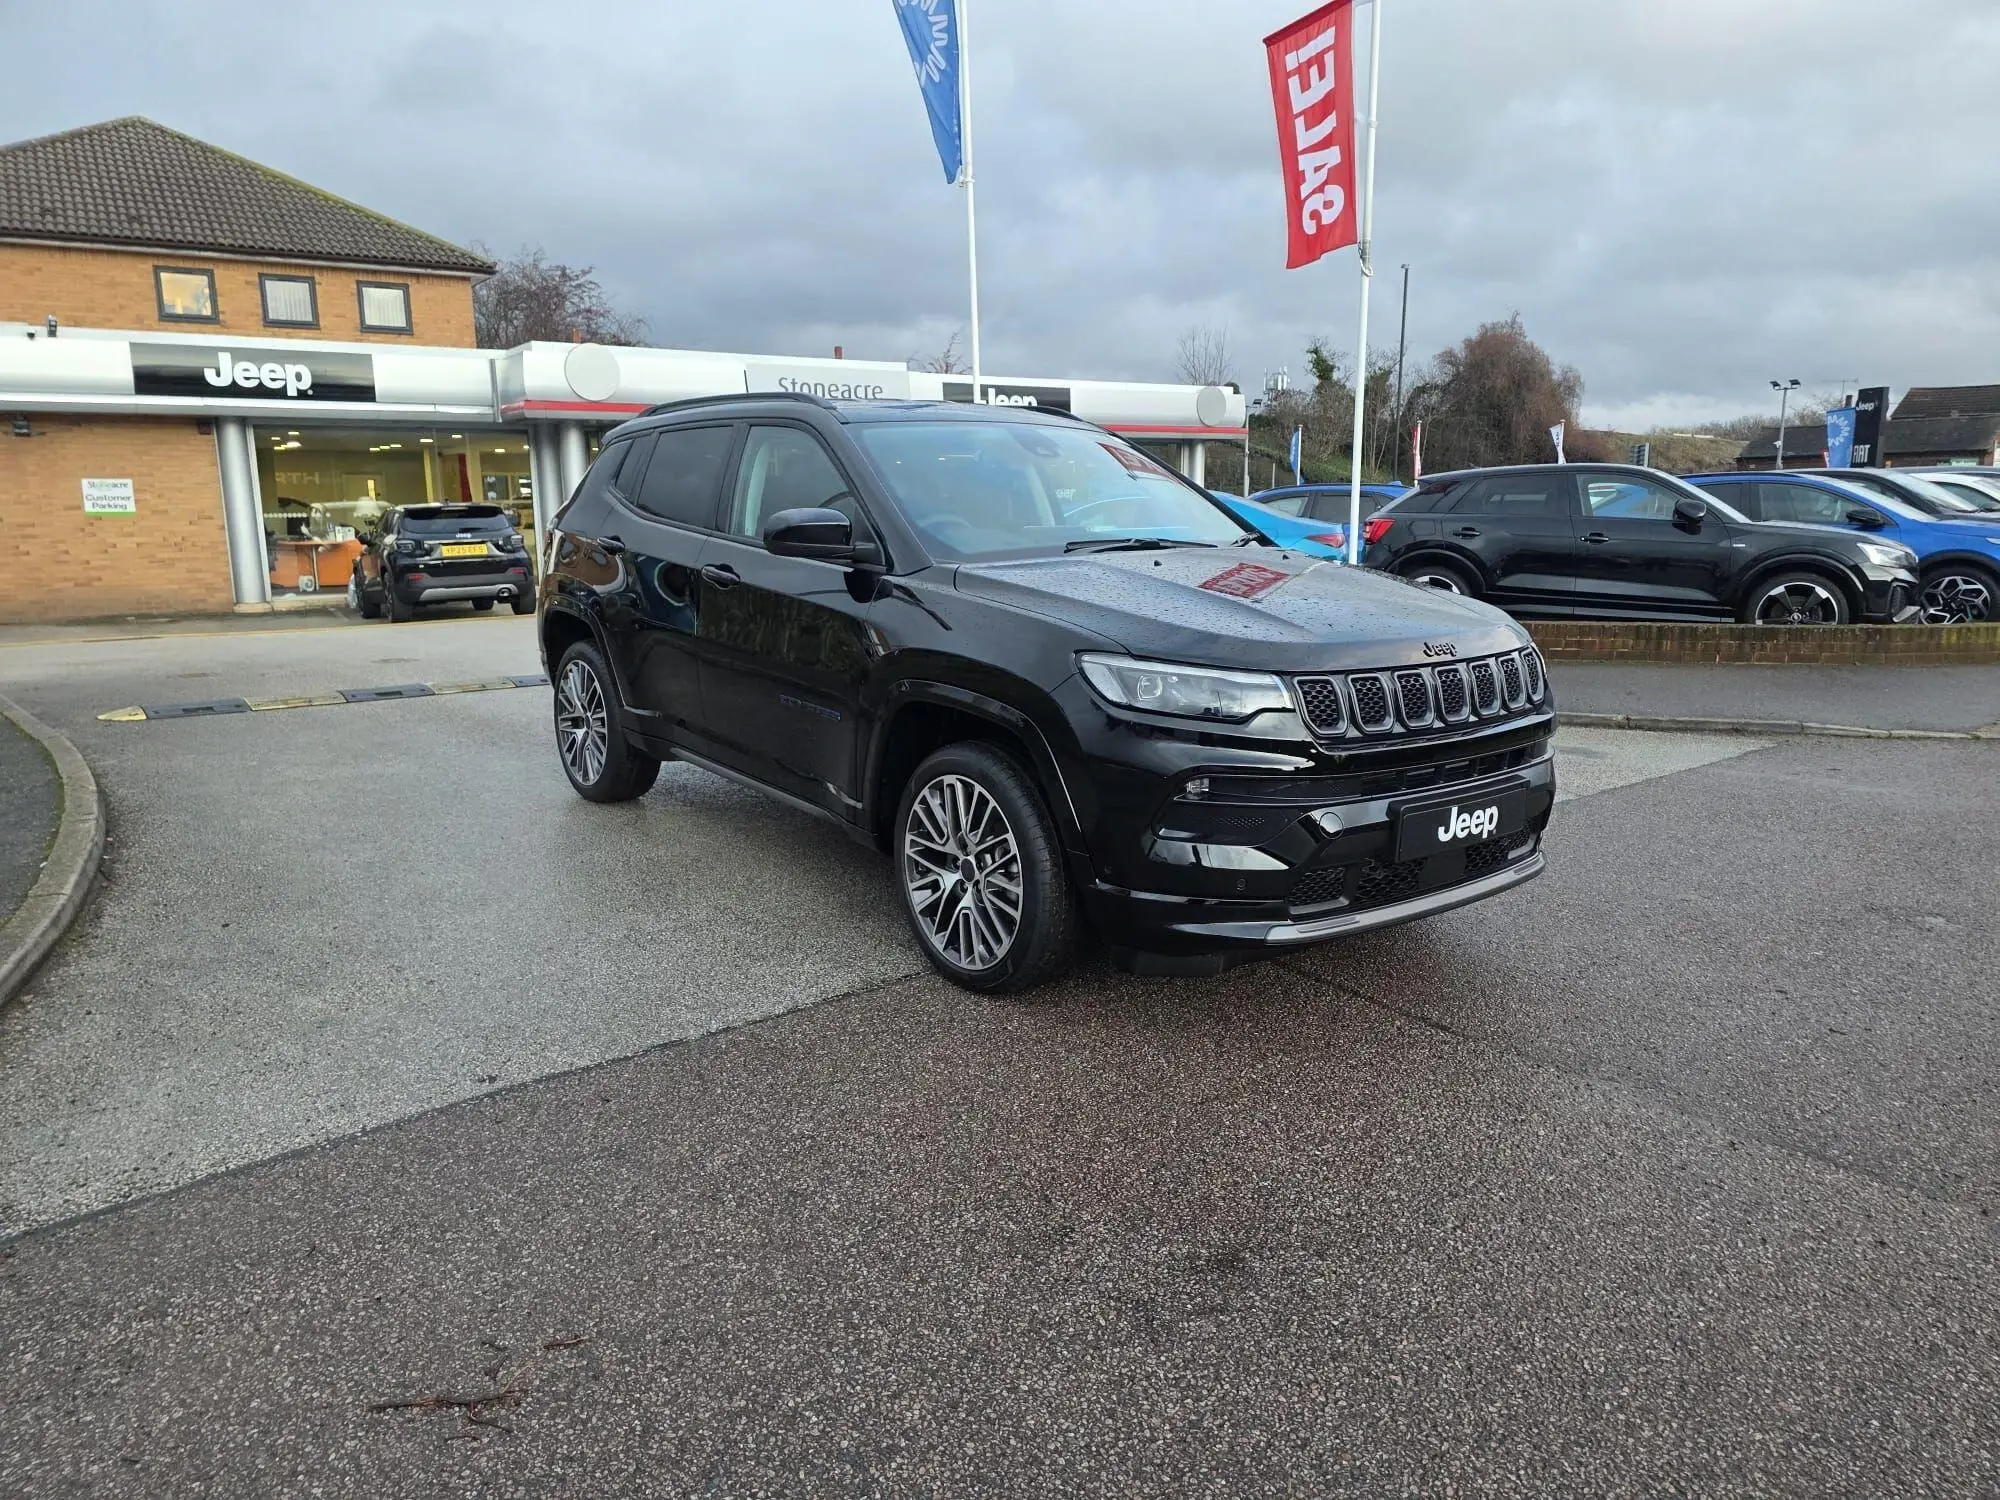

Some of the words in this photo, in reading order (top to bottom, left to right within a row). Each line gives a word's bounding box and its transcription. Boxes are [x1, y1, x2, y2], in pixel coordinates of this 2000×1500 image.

[203, 352, 312, 397] Jeep
[778, 376, 883, 400] Stoneacre
[85, 494, 132, 502] Customer
[92, 502, 128, 511] Parking
[1422, 641, 1457, 658] Jeep
[1437, 805, 1499, 842] Jeep
